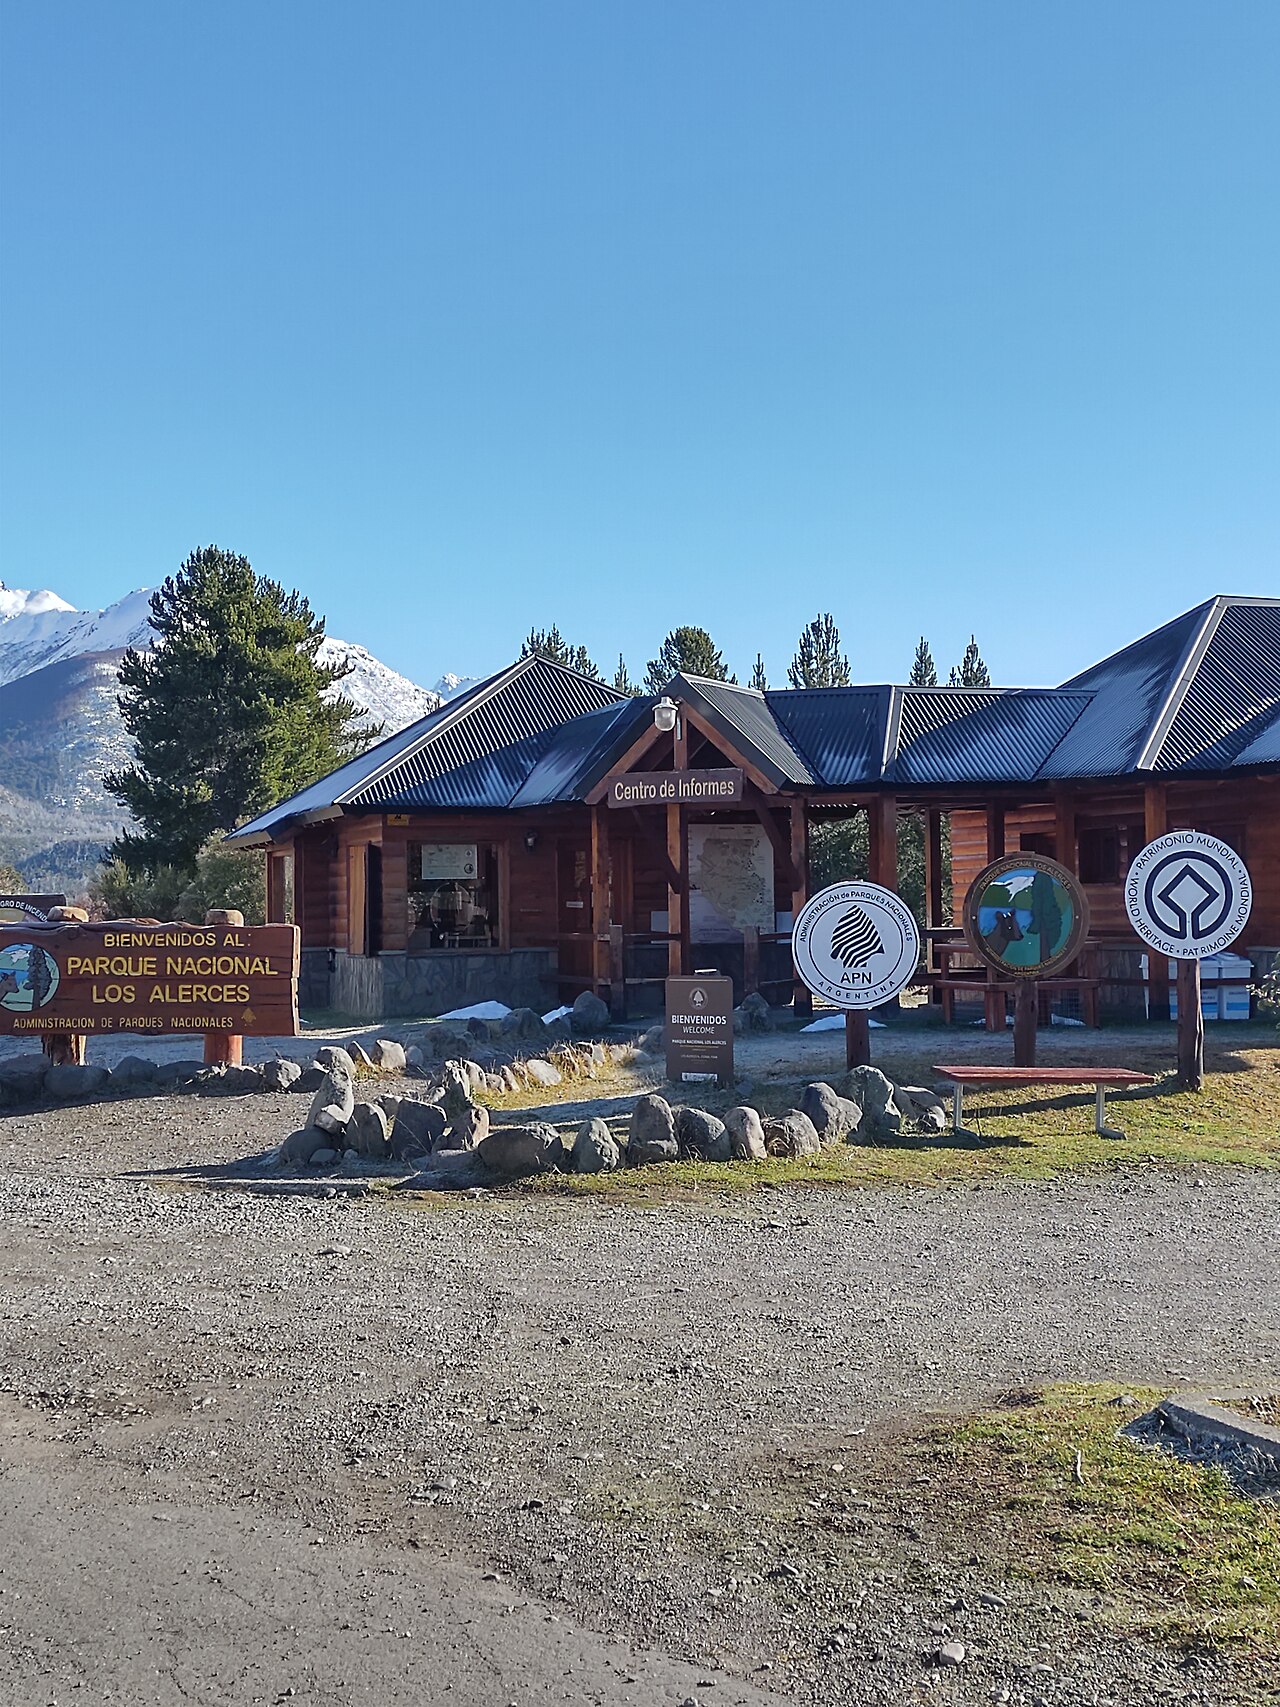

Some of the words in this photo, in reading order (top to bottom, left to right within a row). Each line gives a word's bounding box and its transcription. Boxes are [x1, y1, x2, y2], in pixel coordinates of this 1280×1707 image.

[614, 781, 656, 800] Centro
[659, 780, 675, 798] de
[679, 777, 734, 797] Informes
[1136, 834, 1194, 870] PATRIMONIO
[1196, 837, 1239, 870] MUNDIAL
[15, 901, 25, 910] DE
[1235, 874, 1250, 925] MONDIAL
[800, 893, 840, 942] ADMINISTRACIÓN
[850, 891, 885, 904] PARQUES
[885, 901, 912, 942] NACIONALES
[1127, 876, 1141, 917] WORLD
[1135, 918, 1175, 954] HERITAGE
[104, 933, 216, 947] BIENVENIDOS
[223, 933, 251, 947] AL:
[67, 957, 157, 976] PARQUE
[166, 957, 278, 975] NACIONAL
[841, 972, 872, 984] APN
[92, 985, 135, 1003] LOS
[149, 985, 250, 1003] ALERCES
[818, 981, 896, 999] ARGENTINA
[13, 1016, 95, 1029] ADMINISTRACION
[101, 1016, 113, 1028] DE
[119, 1017, 163, 1028] PARQUES
[171, 1017, 233, 1028] NACIONALES
[671, 1015, 727, 1025] BIENVENIDOS
[682, 1026, 715, 1034] WELCOME
